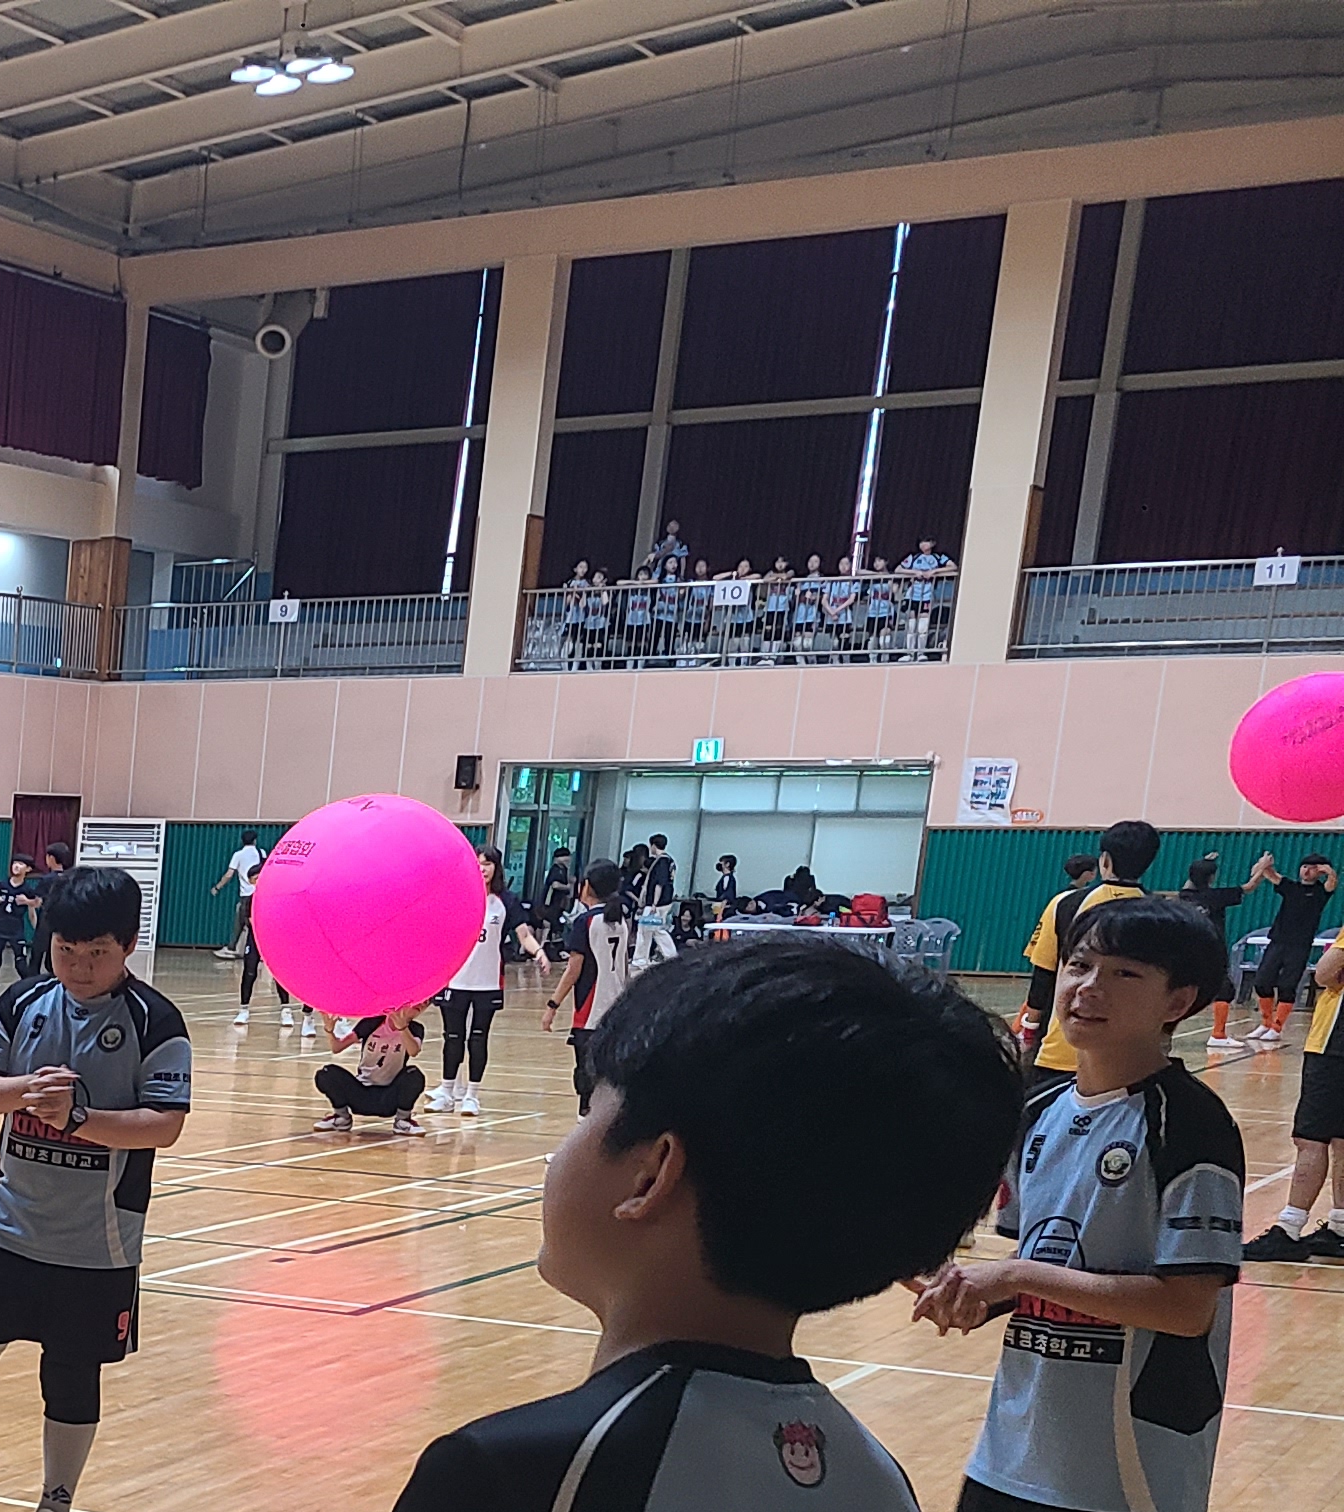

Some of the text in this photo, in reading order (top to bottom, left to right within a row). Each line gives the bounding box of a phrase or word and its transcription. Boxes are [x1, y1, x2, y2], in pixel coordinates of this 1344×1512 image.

[1266, 563, 1286, 579] 11
[720, 585, 743, 600] 10
[279, 604, 289, 618] 9
[607, 936, 620, 972] 7
[29, 1012, 48, 1039] 9
[117, 1311, 130, 1341] 9
